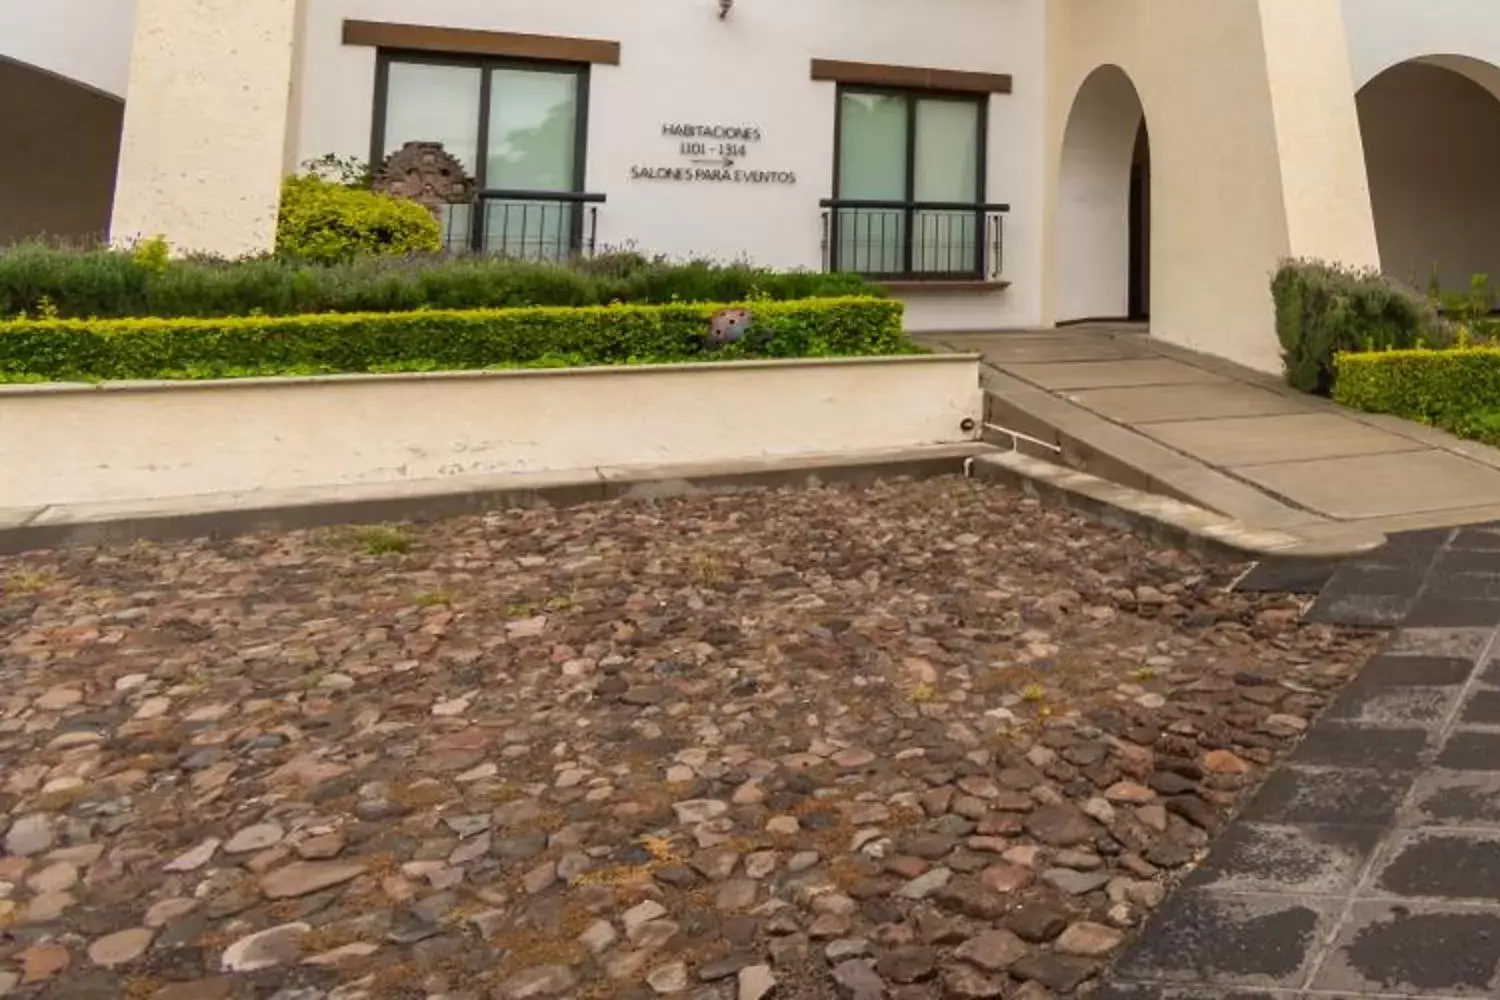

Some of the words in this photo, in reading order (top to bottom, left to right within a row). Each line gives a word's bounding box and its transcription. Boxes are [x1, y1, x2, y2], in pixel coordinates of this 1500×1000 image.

[661, 123, 761, 142] HABITACIONES
[680, 142, 705, 156] 1101
[718, 143, 747, 157] 1314
[631, 165, 692, 182] SALONES
[695, 168, 731, 182] PARA
[734, 169, 797, 184] EVENTOS
